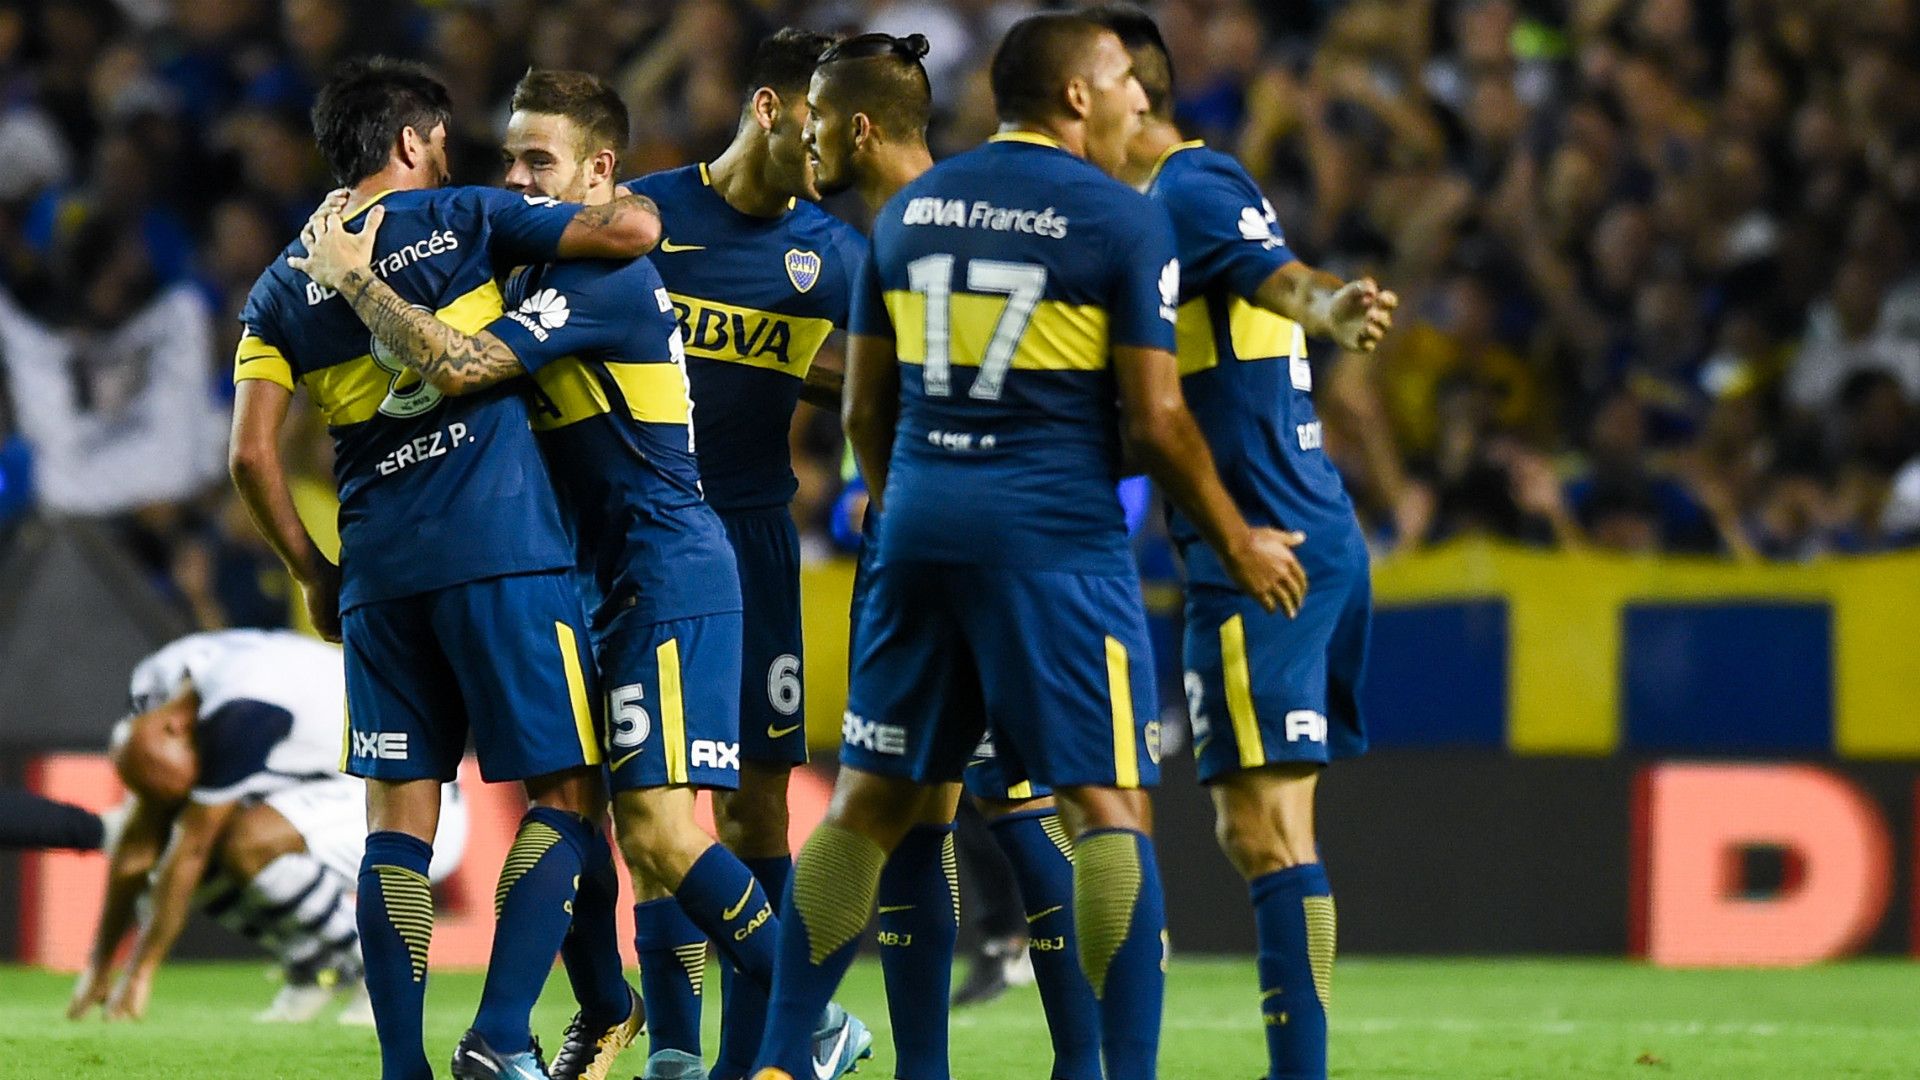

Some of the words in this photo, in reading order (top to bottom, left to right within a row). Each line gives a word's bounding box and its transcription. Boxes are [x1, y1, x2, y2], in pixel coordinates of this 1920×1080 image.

[968, 200, 1069, 240] Francés
[907, 253, 1048, 400] 17
[448, 422, 475, 448] P.
[767, 653, 801, 716] 6
[610, 682, 651, 748] 5
[841, 711, 906, 756] AXE
[352, 729, 408, 760] AXE
[877, 930, 912, 946] ABJ
